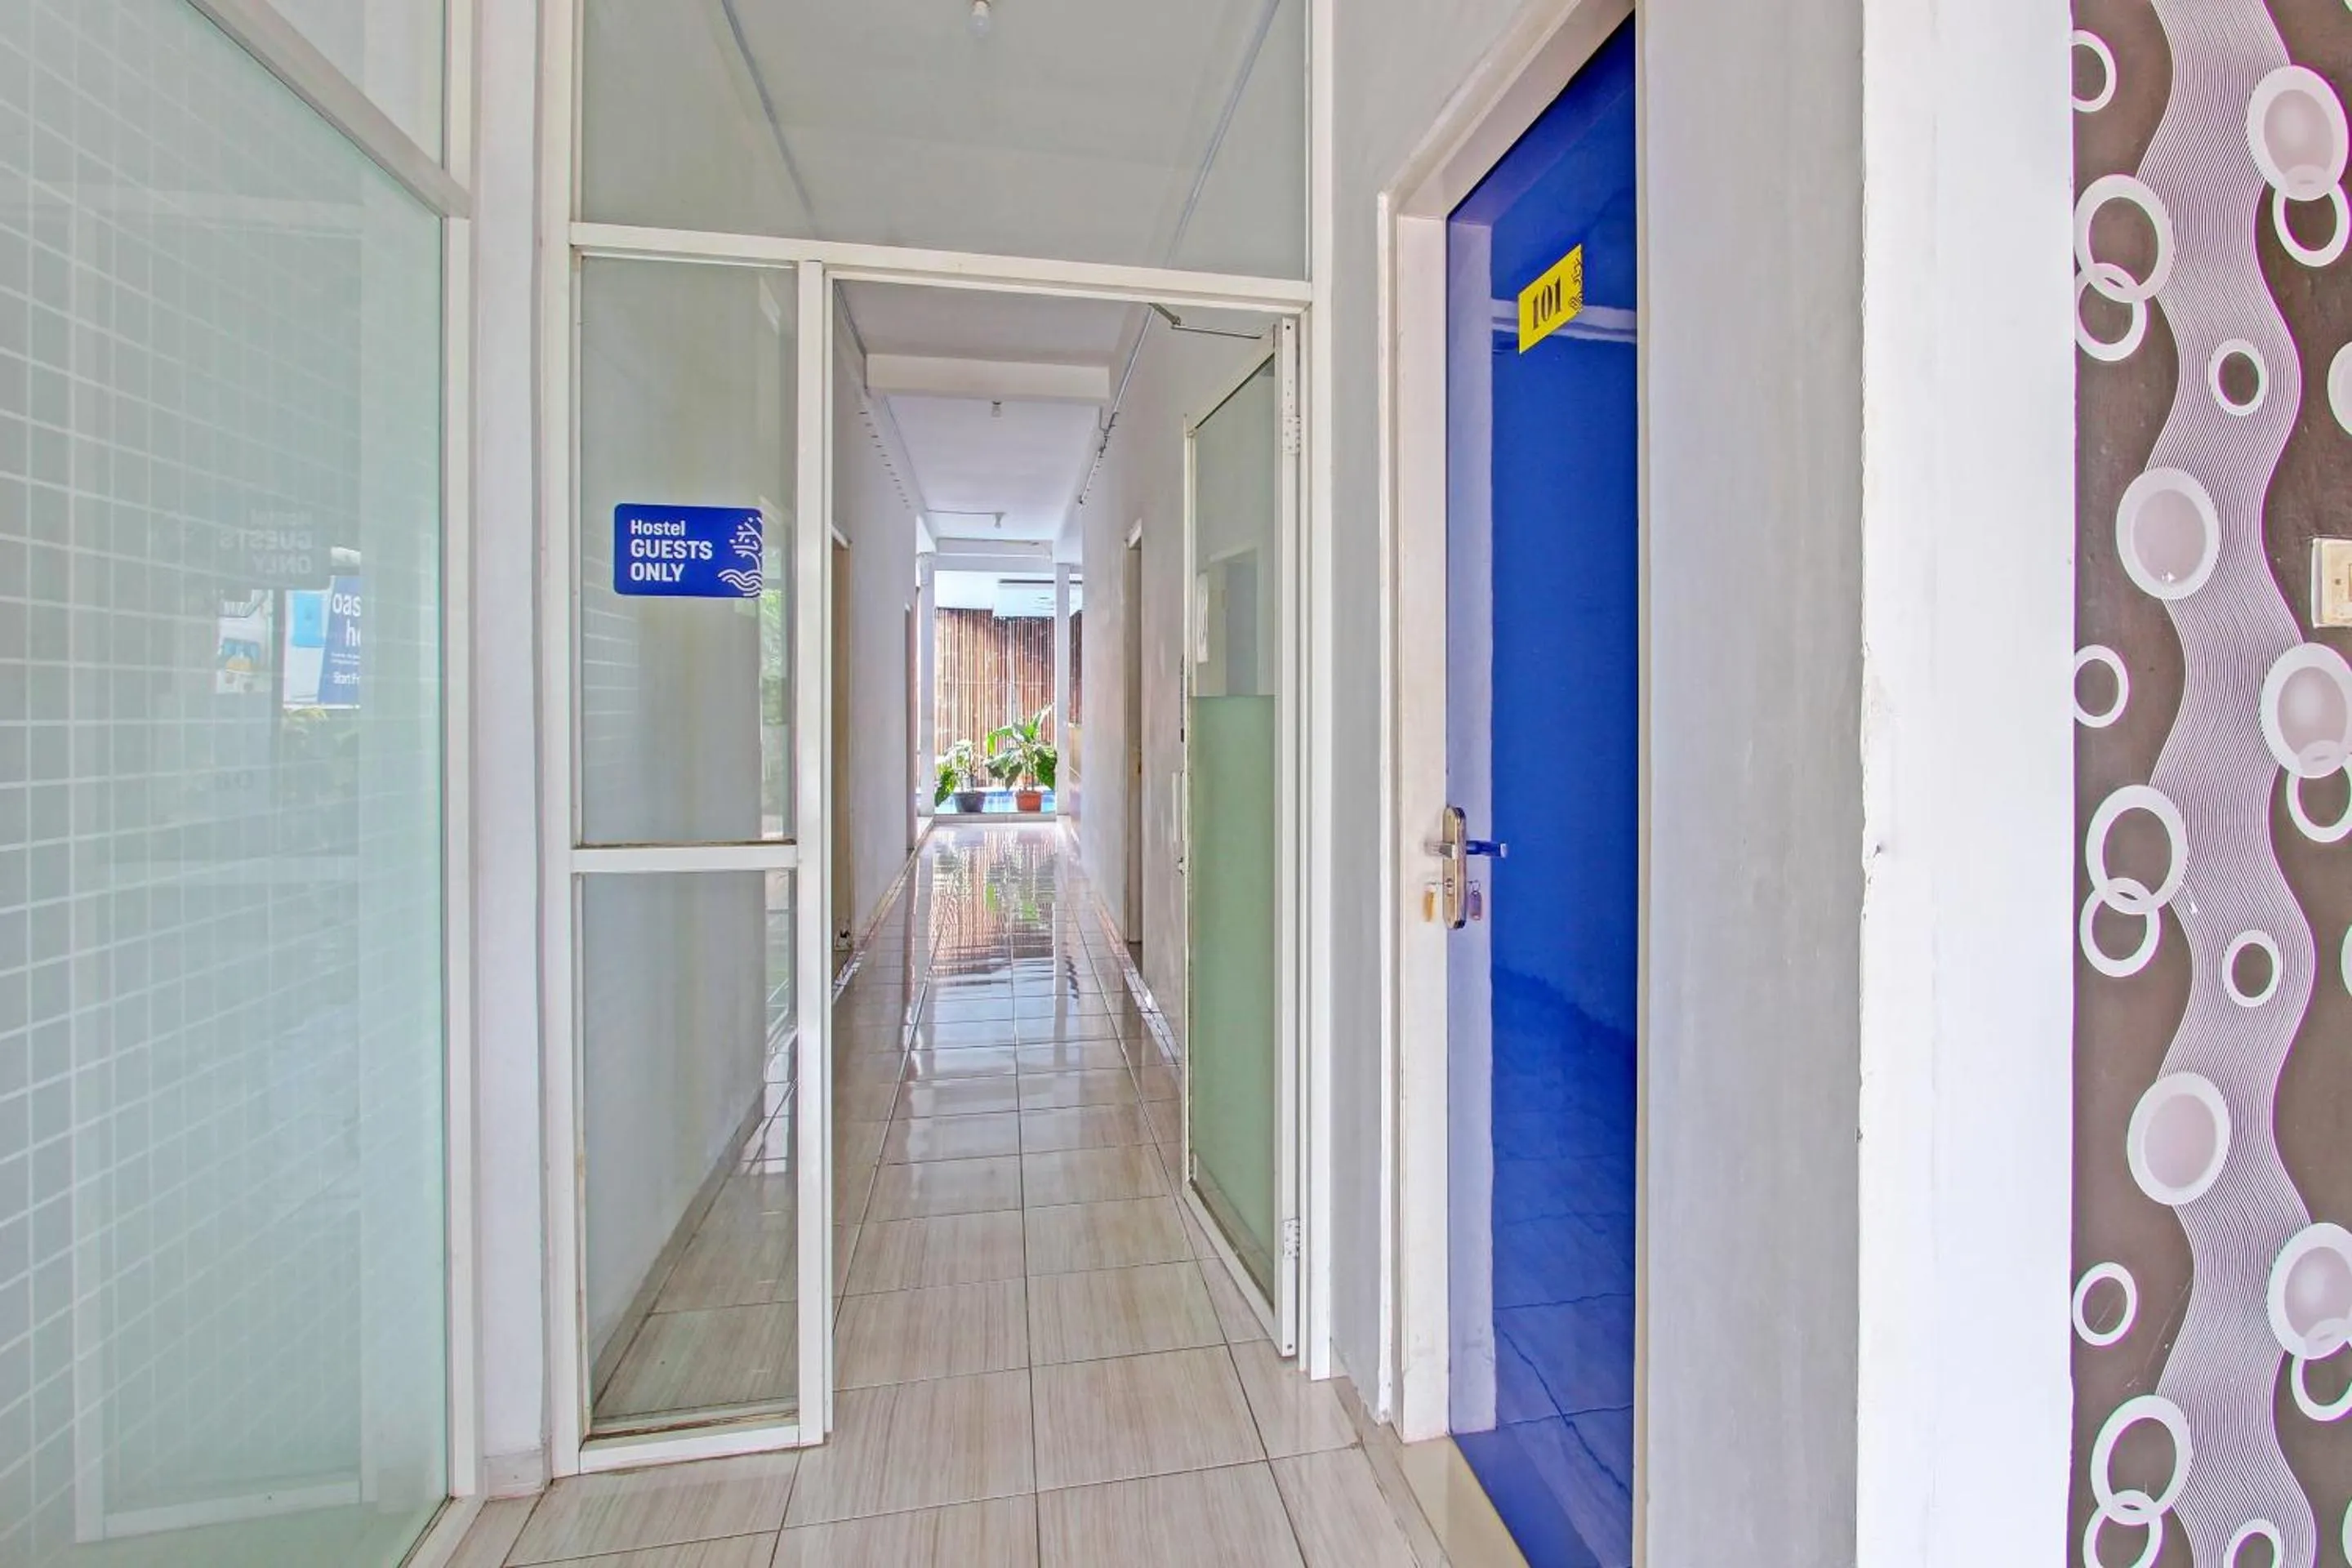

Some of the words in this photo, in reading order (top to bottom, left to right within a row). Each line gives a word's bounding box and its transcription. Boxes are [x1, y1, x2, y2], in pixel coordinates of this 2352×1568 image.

[1532, 274, 1561, 331] 101
[630, 519, 686, 536] Hostel
[630, 539, 713, 559] GUESTS
[630, 562, 684, 582] ONLY
